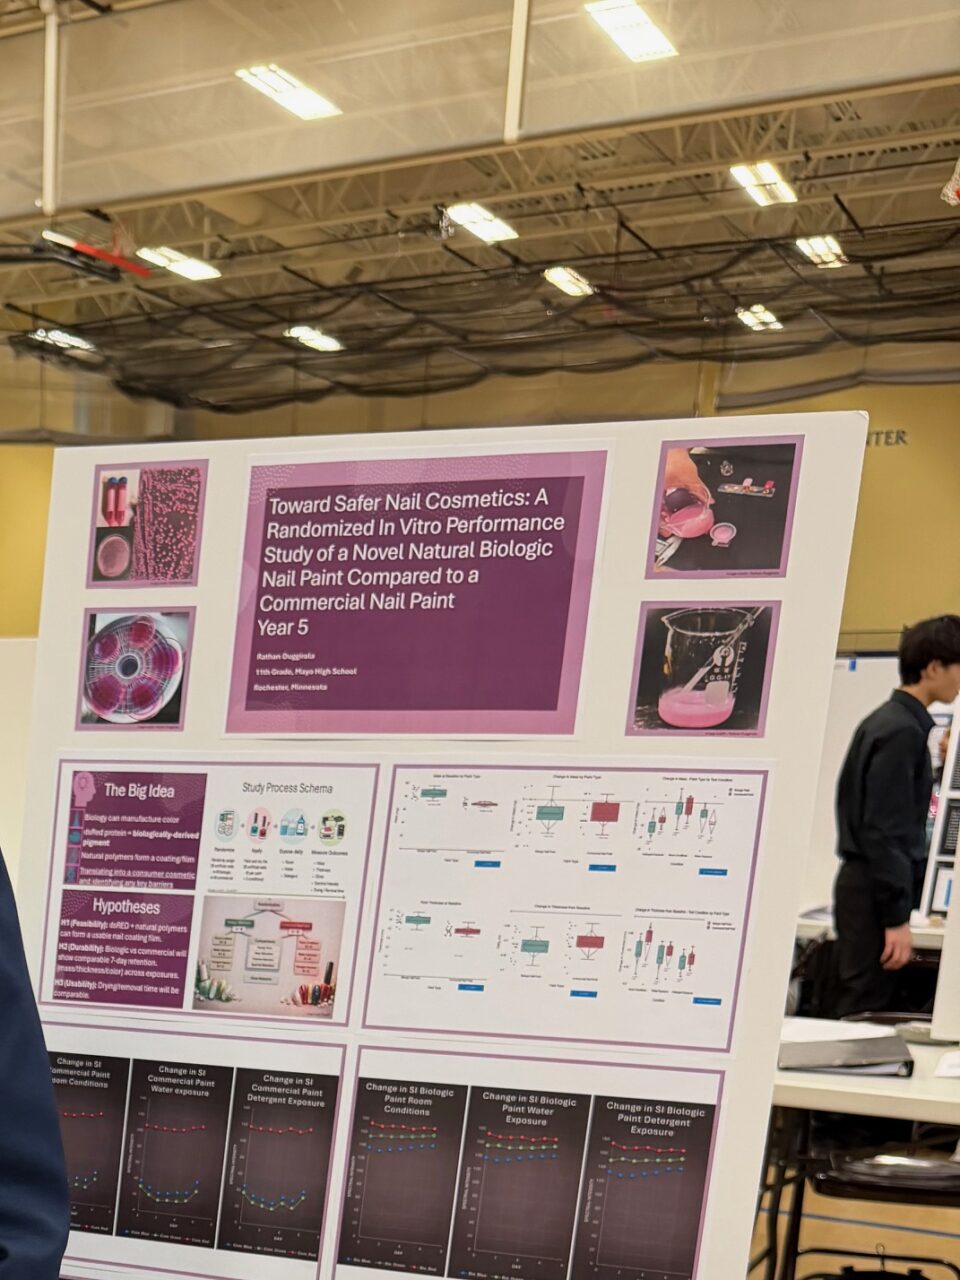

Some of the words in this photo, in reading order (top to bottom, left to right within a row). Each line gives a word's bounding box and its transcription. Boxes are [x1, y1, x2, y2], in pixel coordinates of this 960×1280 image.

[270, 496, 331, 515] Toward
[334, 495, 382, 512] Safer
[385, 492, 421, 511] Nail
[426, 489, 530, 509] Cosmetics:
[534, 488, 549, 506] A
[267, 519, 374, 539] Randomized
[379, 518, 395, 536] In
[400, 517, 442, 535] Vitro
[447, 515, 565, 534] Performance
[264, 546, 313, 566] Study
[316, 545, 335, 562] of
[338, 549, 348, 562] a
[353, 543, 403, 561] Novel
[409, 541, 475, 559] Natural
[480, 539, 553, 560] Biologic
[262, 570, 296, 588] Nail
[300, 569, 344, 586] Paint
[348, 567, 441, 588] Compared
[446, 568, 464, 584] to
[468, 571, 479, 584] a
[260, 594, 365, 612] Commercial
[370, 593, 406, 611] Nail
[410, 592, 455, 609] Paint
[258, 620, 294, 636] Year
[298, 619, 309, 635] 5
[271, 668, 293, 676] Grade,
[295, 668, 313, 676] Mayo
[315, 668, 331, 676] High
[333, 667, 357, 675] School
[105, 783, 126, 797] The
[128, 784, 147, 800] Big
[149, 784, 175, 798] Idea
[242, 782, 265, 795] Study
[266, 782, 298, 794] Process
[299, 783, 333, 794] Schema
[84, 814, 107, 823] Biology
[121, 815, 161, 823] manufacture
[163, 816, 179, 824] color
[81, 852, 104, 860] Natural
[105, 853, 134, 862] polymers
[135, 854, 150, 862] form
[93, 898, 161, 915] Hypotheses
[158, 926, 188, 934] polymers
[57, 1058, 84, 1068] Change
[86, 1060, 92, 1068] in
[50, 1067, 90, 1077] ommercial
[92, 1071, 110, 1079] Paint
[158, 1065, 187, 1077] Change
[189, 1068, 196, 1076] in
[197, 1068, 206, 1077] SI
[69, 1079, 108, 1089] Conditions
[147, 1074, 192, 1087] Commercial
[194, 1078, 215, 1088] Paint
[263, 1074, 294, 1086] Change
[296, 1077, 303, 1085] in
[305, 1077, 314, 1086] SI
[151, 1085, 173, 1095] Water
[175, 1087, 210, 1099] exposure
[251, 1084, 300, 1096] Commercial
[302, 1087, 323, 1098] Paint
[365, 1082, 398, 1095] Change
[399, 1085, 407, 1094] in
[409, 1085, 418, 1095] SI
[420, 1087, 455, 1099] Biologic
[247, 1093, 287, 1105] Detergent
[288, 1097, 326, 1109] Exposure
[384, 1095, 406, 1105] Paint
[408, 1097, 432, 1106] Room
[482, 1092, 517, 1104] Change
[518, 1095, 527, 1103] in
[529, 1094, 538, 1104] SI
[540, 1095, 577, 1108] Biologic
[384, 1105, 431, 1117] Conditions
[502, 1104, 524, 1115] Paint
[527, 1106, 554, 1117] Water
[606, 1101, 642, 1114] Change
[644, 1104, 653, 1113] in
[655, 1104, 664, 1115] SI
[666, 1106, 706, 1119] Biologic
[505, 1115, 547, 1127] Exposure
[617, 1113, 640, 1125] Paint
[642, 1116, 691, 1129] Detergent
[630, 1125, 674, 1138] Exposure
